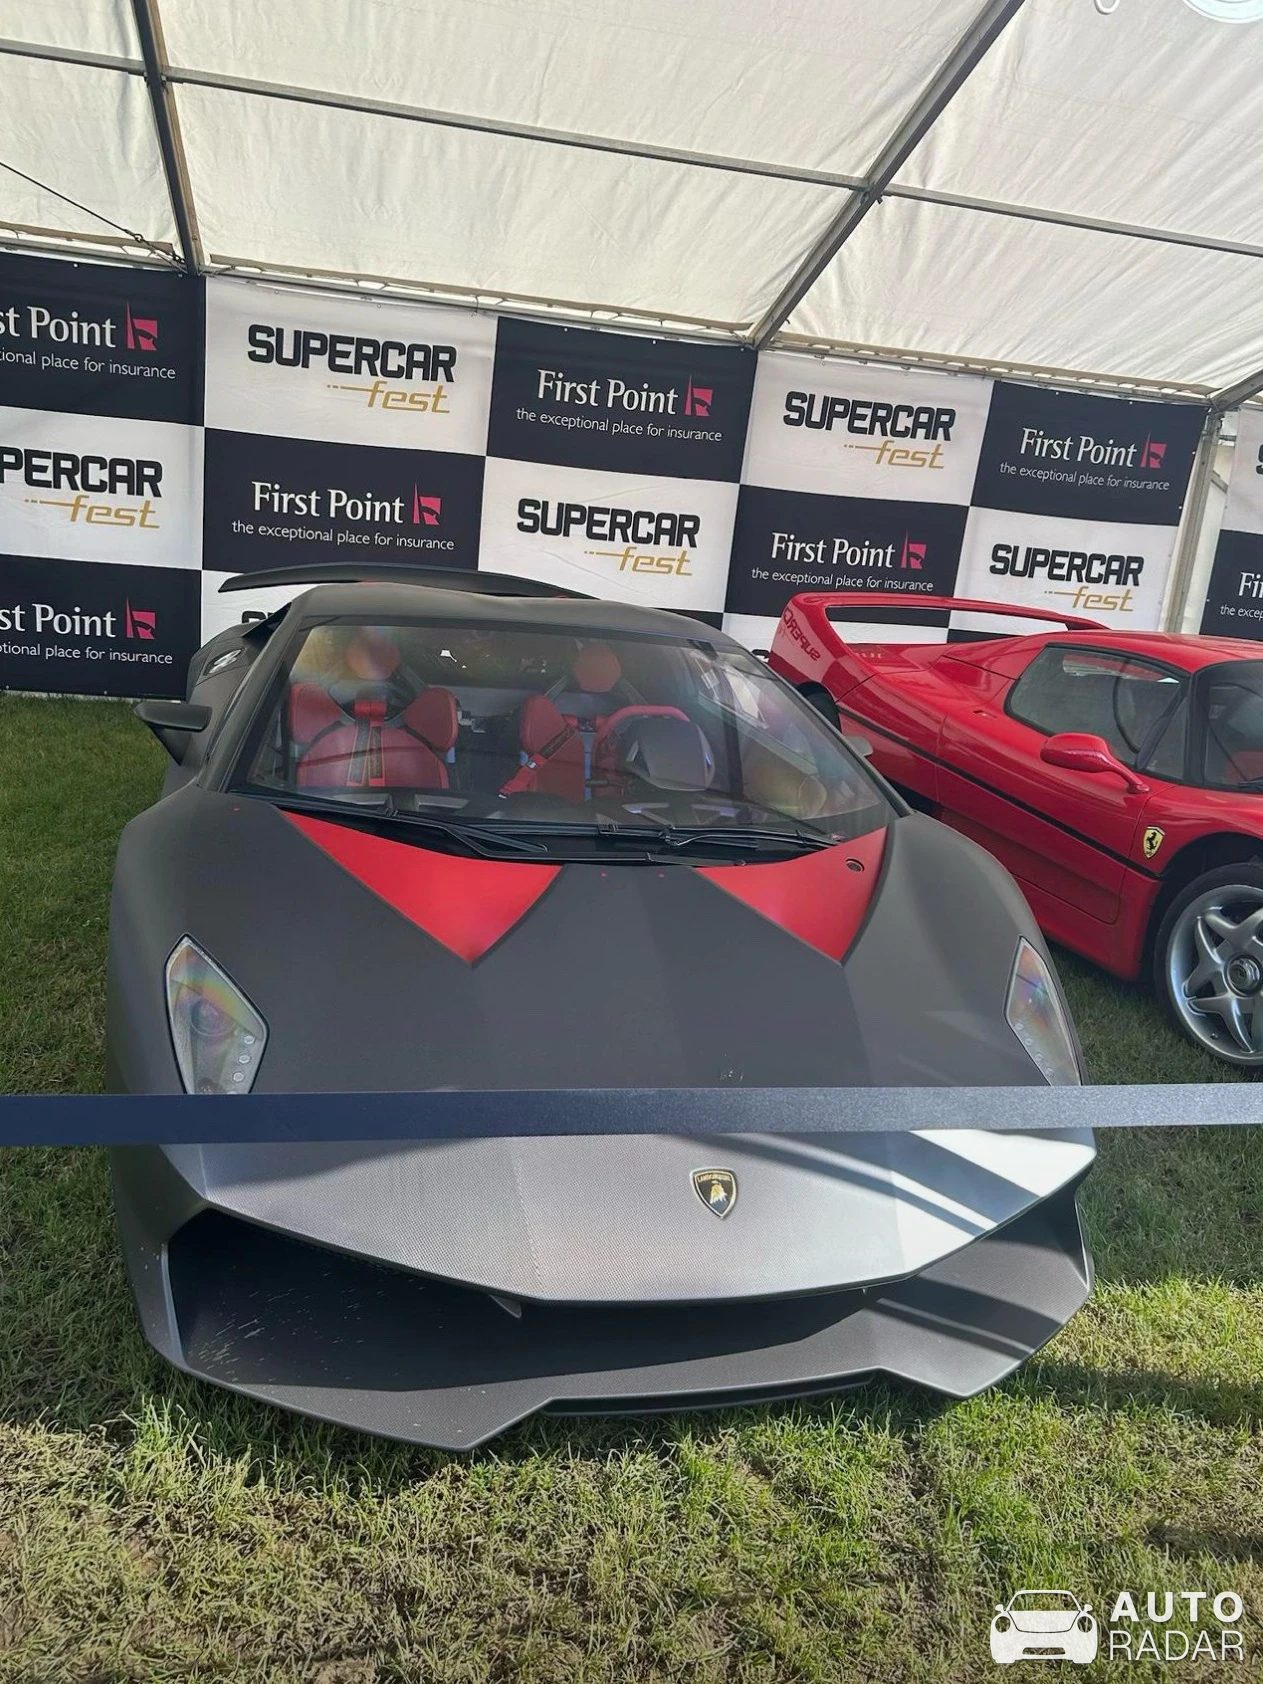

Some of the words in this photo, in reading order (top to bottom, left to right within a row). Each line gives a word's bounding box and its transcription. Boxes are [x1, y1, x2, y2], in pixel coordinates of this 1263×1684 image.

[27, 305, 116, 348] Point
[0, 347, 35, 365] ional
[41, 353, 79, 371] place
[84, 356, 105, 372] for
[109, 359, 176, 379] insurance
[247, 323, 457, 382] SUPERCAR
[367, 380, 450, 413] fest
[538, 369, 600, 407] First
[606, 378, 678, 415] Point
[516, 407, 536, 422] the
[540, 413, 609, 431] exceptional
[611, 420, 643, 436] place
[647, 423, 664, 437] for
[667, 424, 723, 442] insurance
[783, 390, 956, 441] SUPERCAR
[875, 439, 944, 469] fest
[1019, 427, 1074, 461] First
[1076, 435, 1137, 468] Point
[0, 445, 163, 498] PERCAR
[999, 461, 1017, 475] the
[1019, 467, 1077, 483] exceptional
[1078, 473, 1104, 486] place
[1106, 474, 1122, 487] for
[1123, 475, 1170, 491] insurance
[70, 494, 160, 529] fest
[251, 481, 321, 517] First
[327, 488, 405, 524] Point
[231, 520, 254, 534] the
[258, 525, 333, 542] exceptional
[337, 529, 370, 546] place
[374, 532, 393, 546] for
[396, 533, 455, 551] insurance
[516, 497, 701, 548] SUPERCAR
[619, 546, 692, 576] fest
[771, 532, 827, 564] First
[832, 537, 896, 568] Point
[989, 543, 1145, 586] SUPERCAR
[751, 567, 769, 580] the
[772, 571, 833, 585] exceptional
[835, 575, 863, 589] place
[866, 575, 882, 588] for
[884, 577, 934, 592] insurance
[1072, 586, 1133, 612] fest
[1220, 603, 1236, 616] the
[32, 603, 117, 638] Point
[45, 644, 81, 659] place
[85, 646, 105, 660] for
[109, 648, 173, 664] insurance
